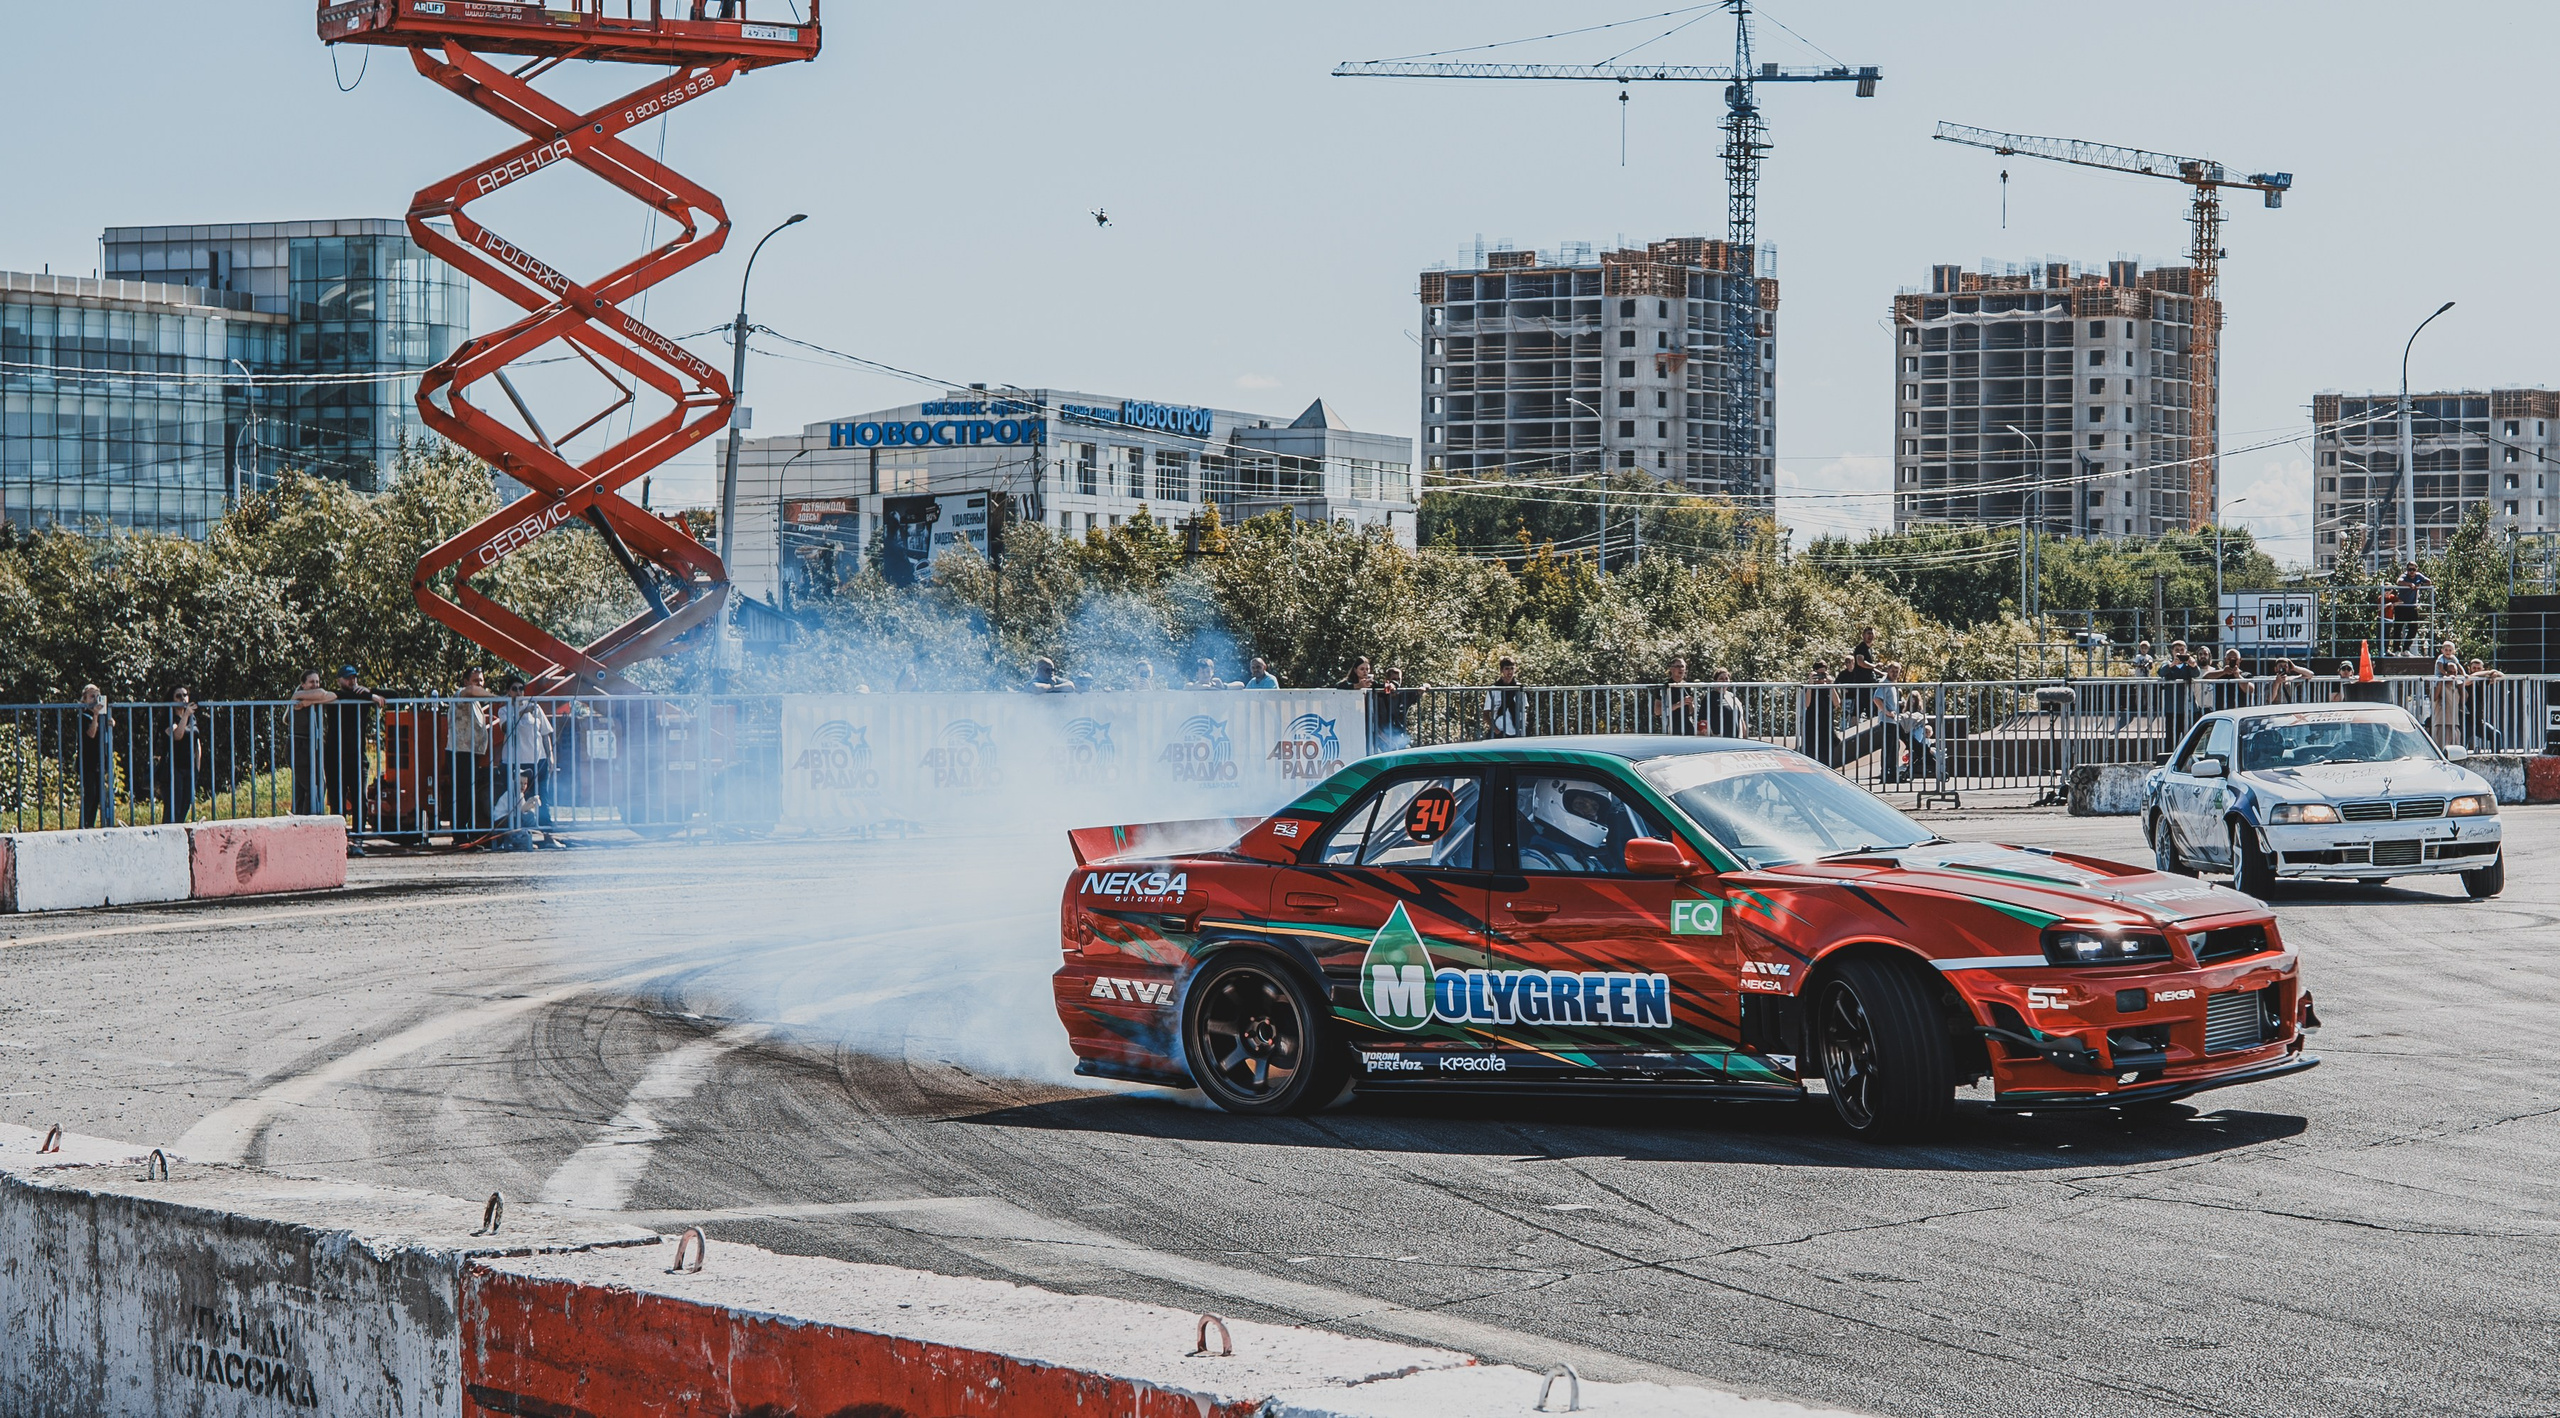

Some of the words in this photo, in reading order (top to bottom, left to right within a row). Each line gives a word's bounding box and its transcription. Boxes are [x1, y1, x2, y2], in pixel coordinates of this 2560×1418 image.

[414, 2, 445, 14] ARLIFT
[625, 111, 635, 123] 8
[636, 99, 660, 118] 800
[660, 88, 685, 107] 555
[685, 82, 698, 96] 19
[698, 74, 716, 91] 28
[477, 139, 572, 194] АРЕНДА
[475, 228, 570, 295] ПРОДАЖА
[623, 316, 713, 379] WWW.ARLIFT.RU
[1123, 401, 1214, 433] НОВОСТРОЙ
[830, 417, 1046, 447] НОВОСТРОЙ
[952, 509, 986, 527] УДАЛЕННЫЙ
[791, 749, 848, 769] АВТО
[918, 748, 975, 768] АВТО
[1157, 742, 1210, 763] АВТО
[1267, 741, 1319, 760] АВТО
[811, 769, 879, 790] РАДИО
[934, 767, 1003, 788] РАДИО
[1172, 761, 1239, 782] РАДИО
[1282, 760, 1345, 779] РАДИО
[1411, 800, 1450, 831] 34
[1080, 872, 1187, 895] NEKSA
[1675, 902, 1718, 931] FQ
[1741, 961, 1790, 976] ATVL
[1090, 976, 1174, 1006] ATVL
[1371, 965, 1670, 1026] MOLYGREEN
[1741, 979, 1781, 991] NEKSA
[2154, 989, 2196, 1003] NEKSA
[1362, 1052, 1400, 1064] VORONA
